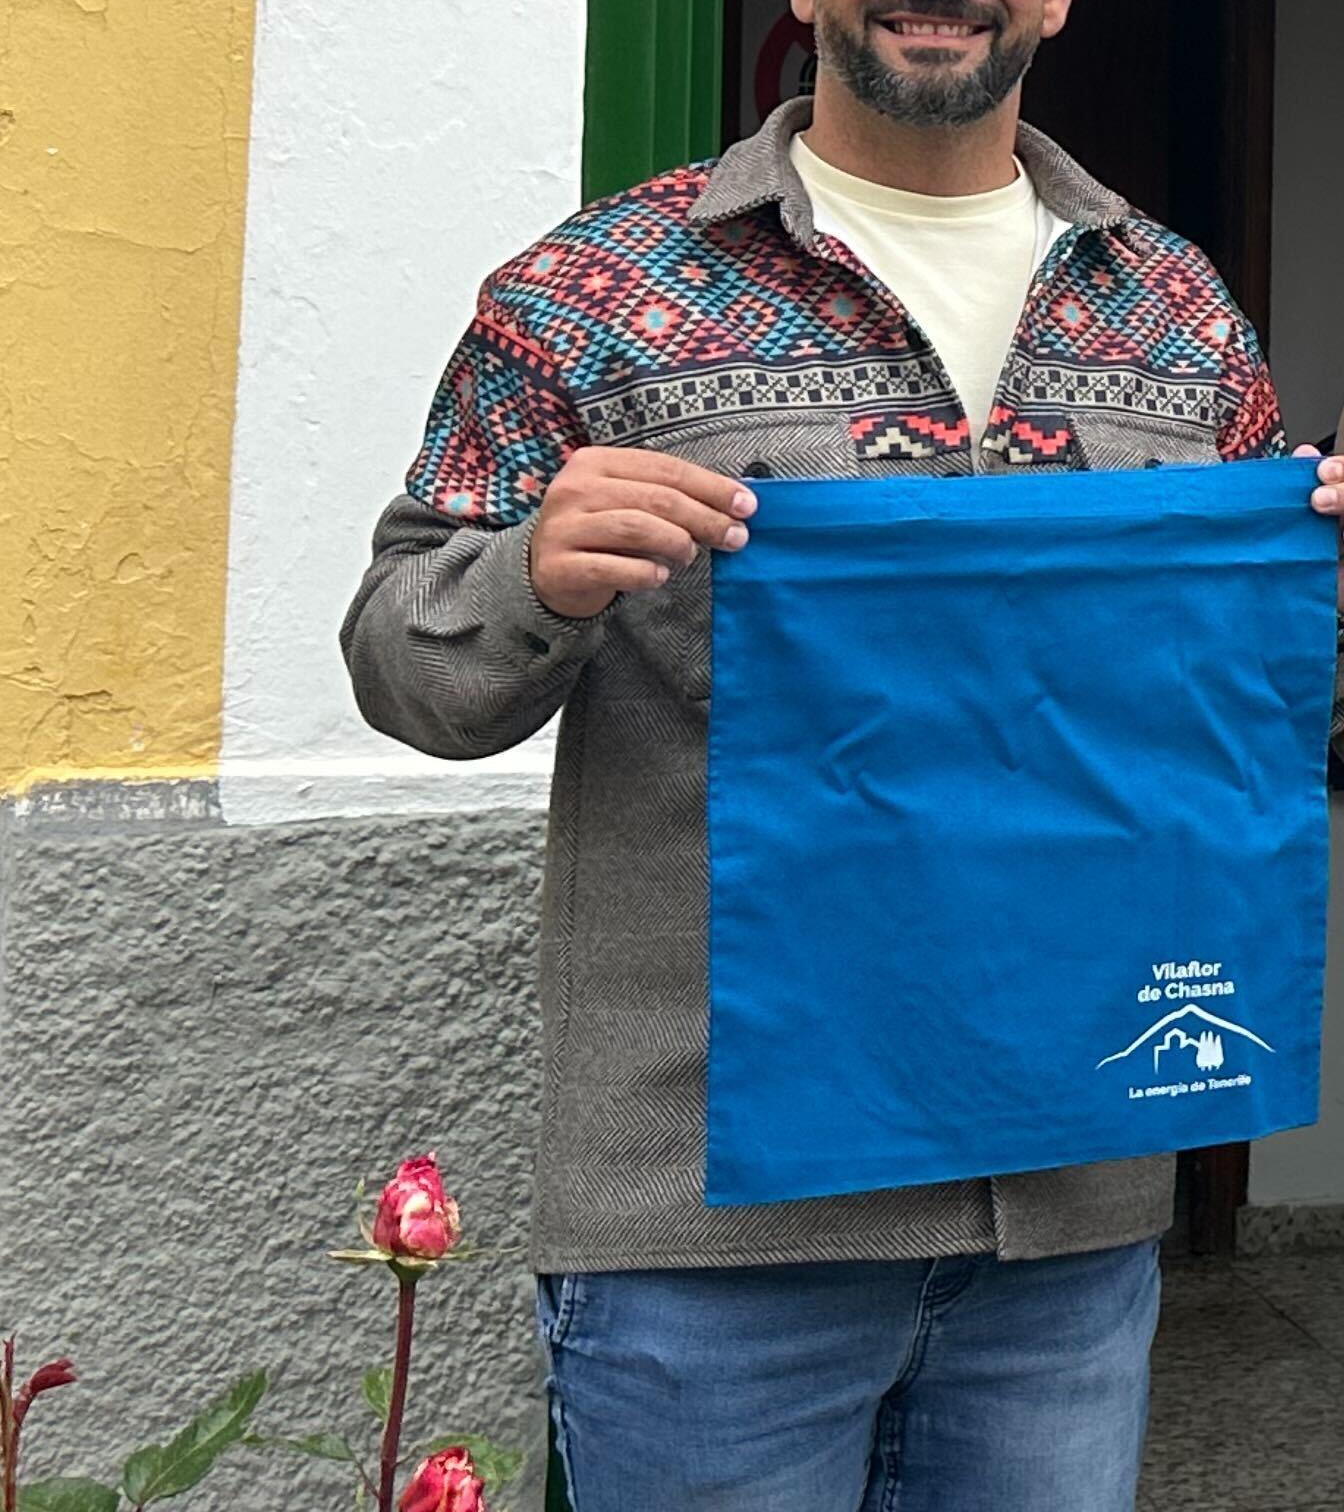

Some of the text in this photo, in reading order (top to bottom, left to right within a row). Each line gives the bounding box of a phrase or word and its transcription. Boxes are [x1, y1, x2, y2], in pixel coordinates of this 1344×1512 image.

[1151, 959, 1223, 981] Vilaflor
[1136, 979, 1236, 1003] de Chasna
[1128, 1086, 1145, 1100] La
[1189, 1080, 1207, 1093] de
